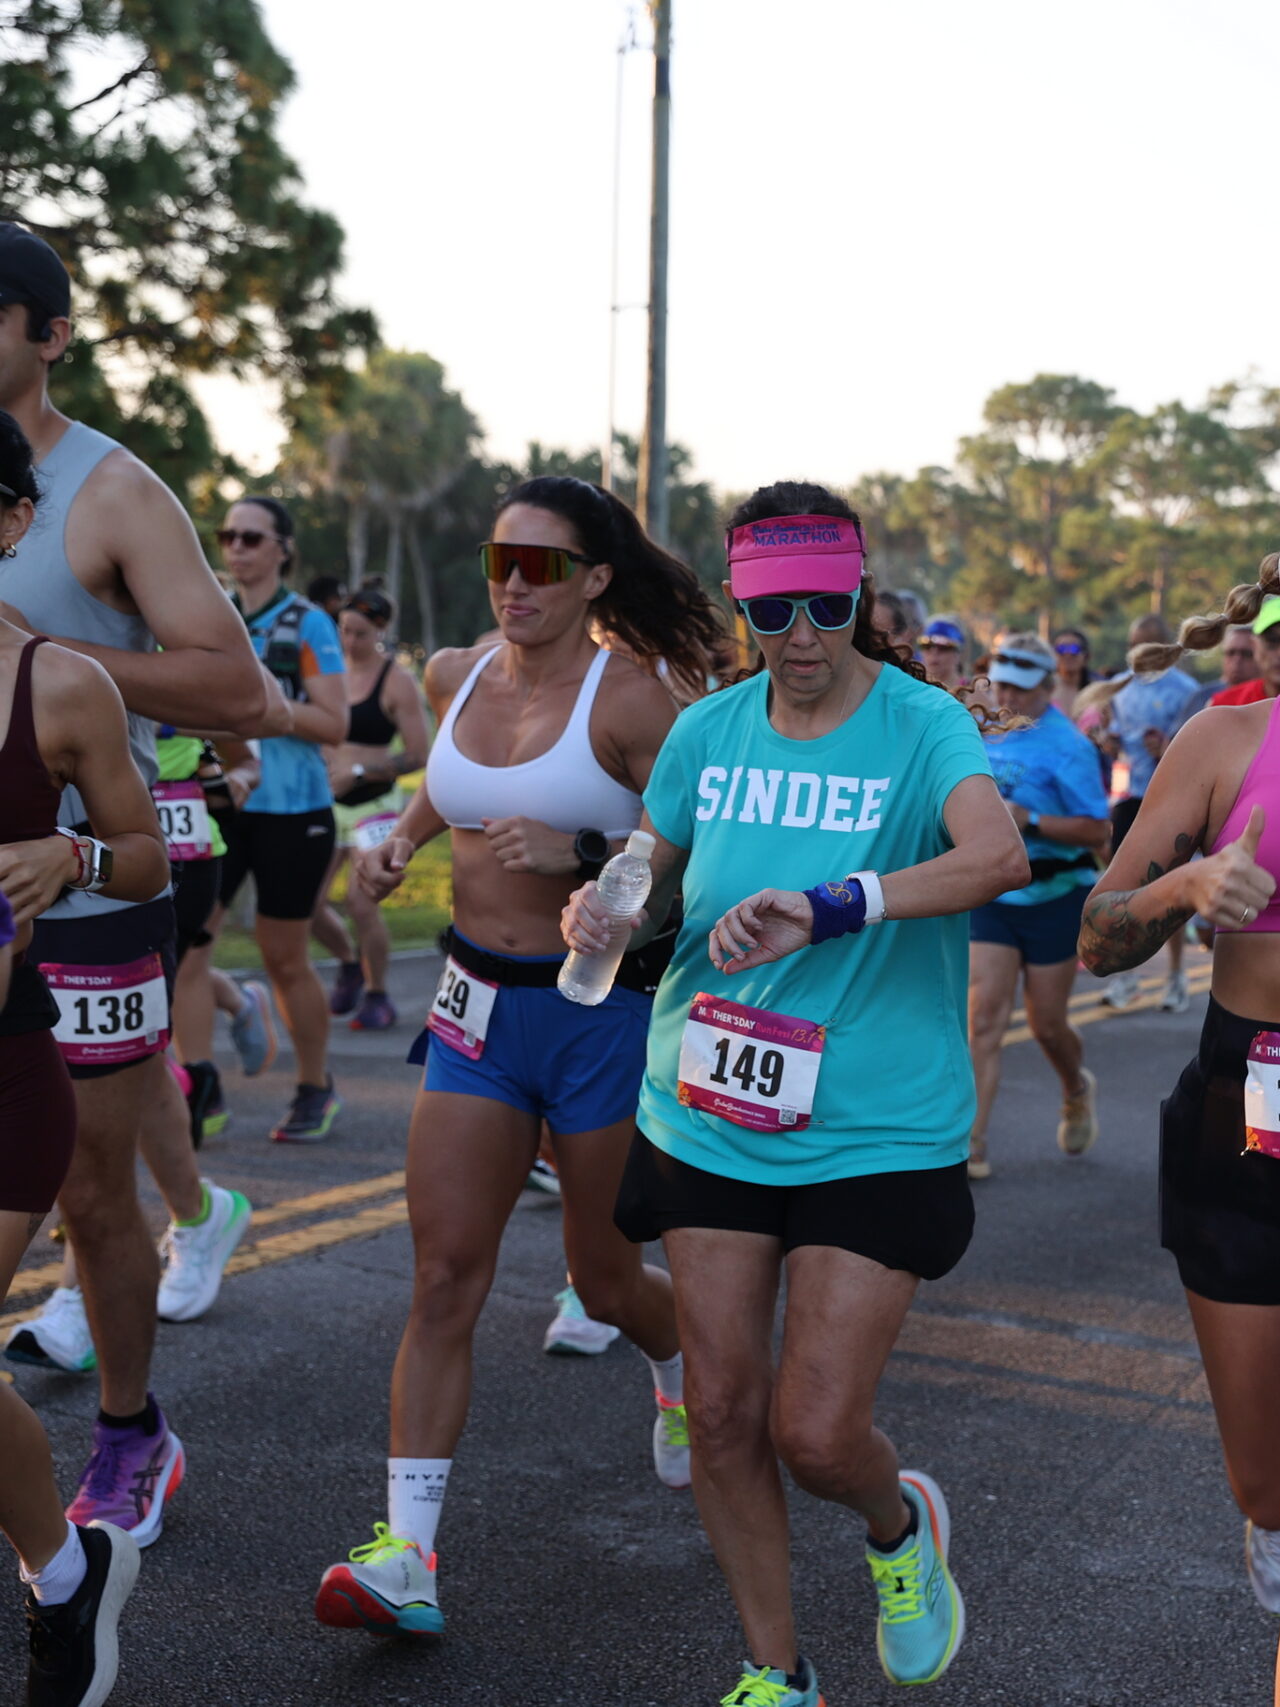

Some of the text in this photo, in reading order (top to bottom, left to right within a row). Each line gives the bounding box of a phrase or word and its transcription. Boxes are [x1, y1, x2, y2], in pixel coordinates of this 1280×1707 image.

[753, 529, 841, 547] MARATHON
[695, 765, 891, 833] SINDEE
[157, 805, 192, 836] 03
[74, 991, 144, 1036] 138
[790, 1027, 815, 1044] 13.1
[710, 1037, 785, 1098] 149
